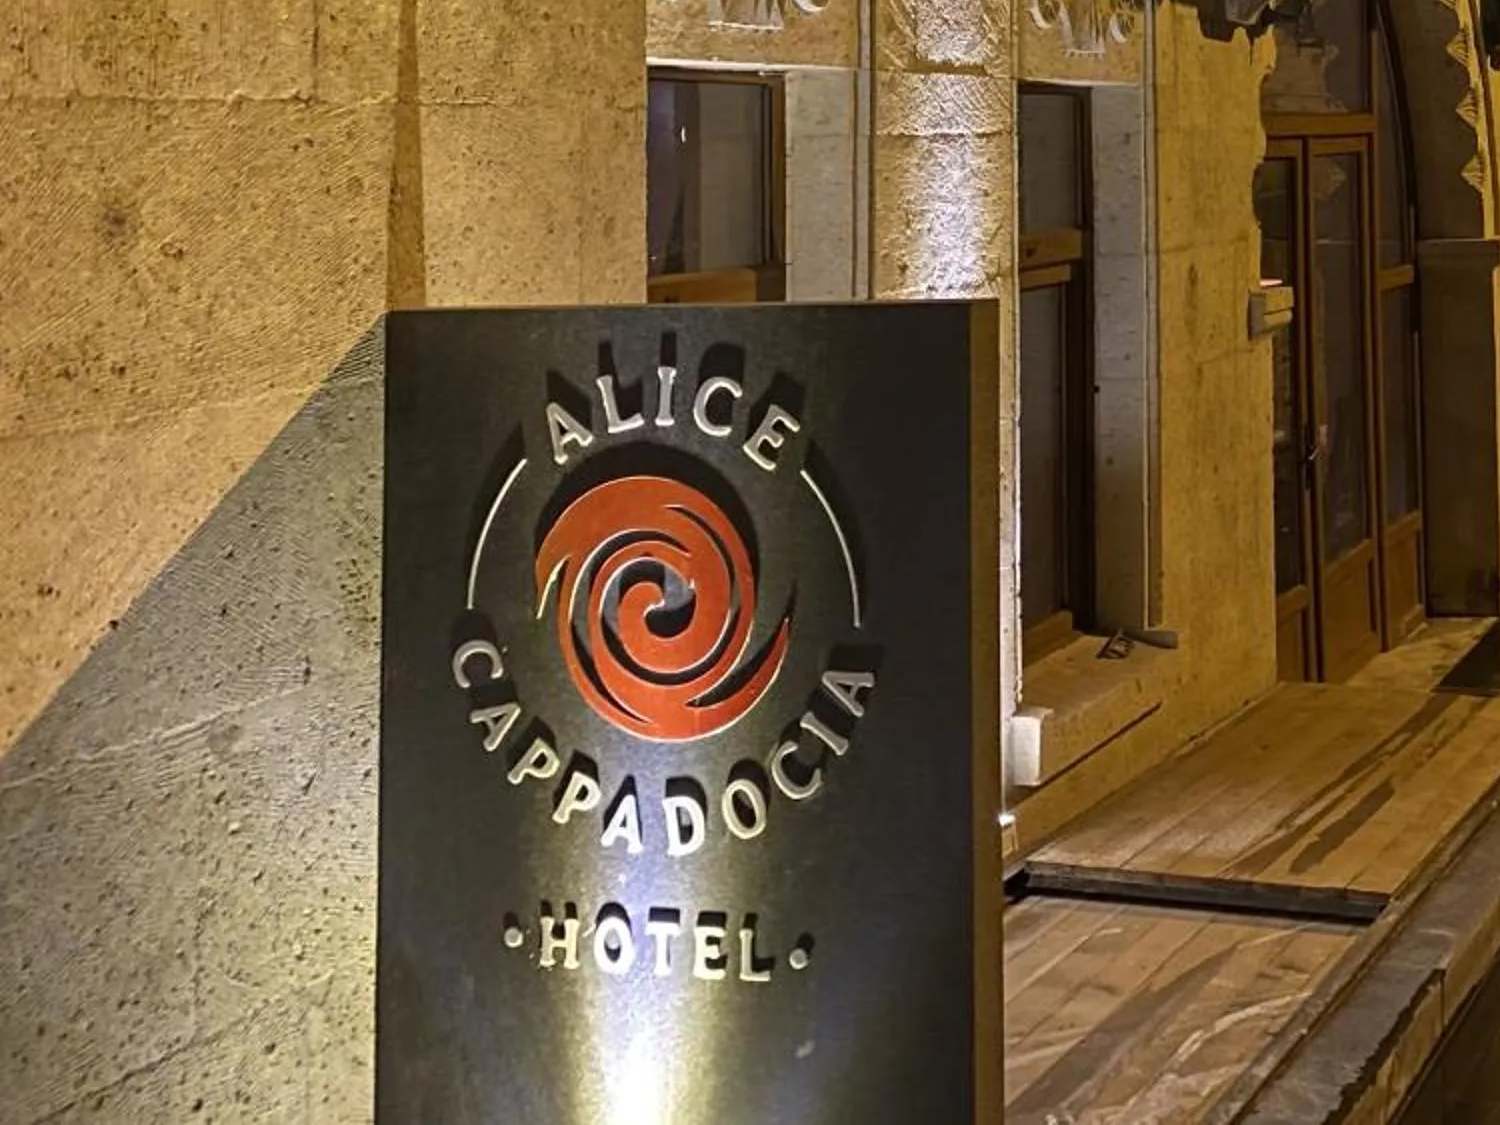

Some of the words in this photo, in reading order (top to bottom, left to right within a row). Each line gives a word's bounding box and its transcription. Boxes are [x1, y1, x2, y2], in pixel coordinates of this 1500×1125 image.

[545, 366, 801, 471] ALICE
[452, 638, 876, 858] CAPPADOCIA
[540, 915, 773, 984] HOTEL
